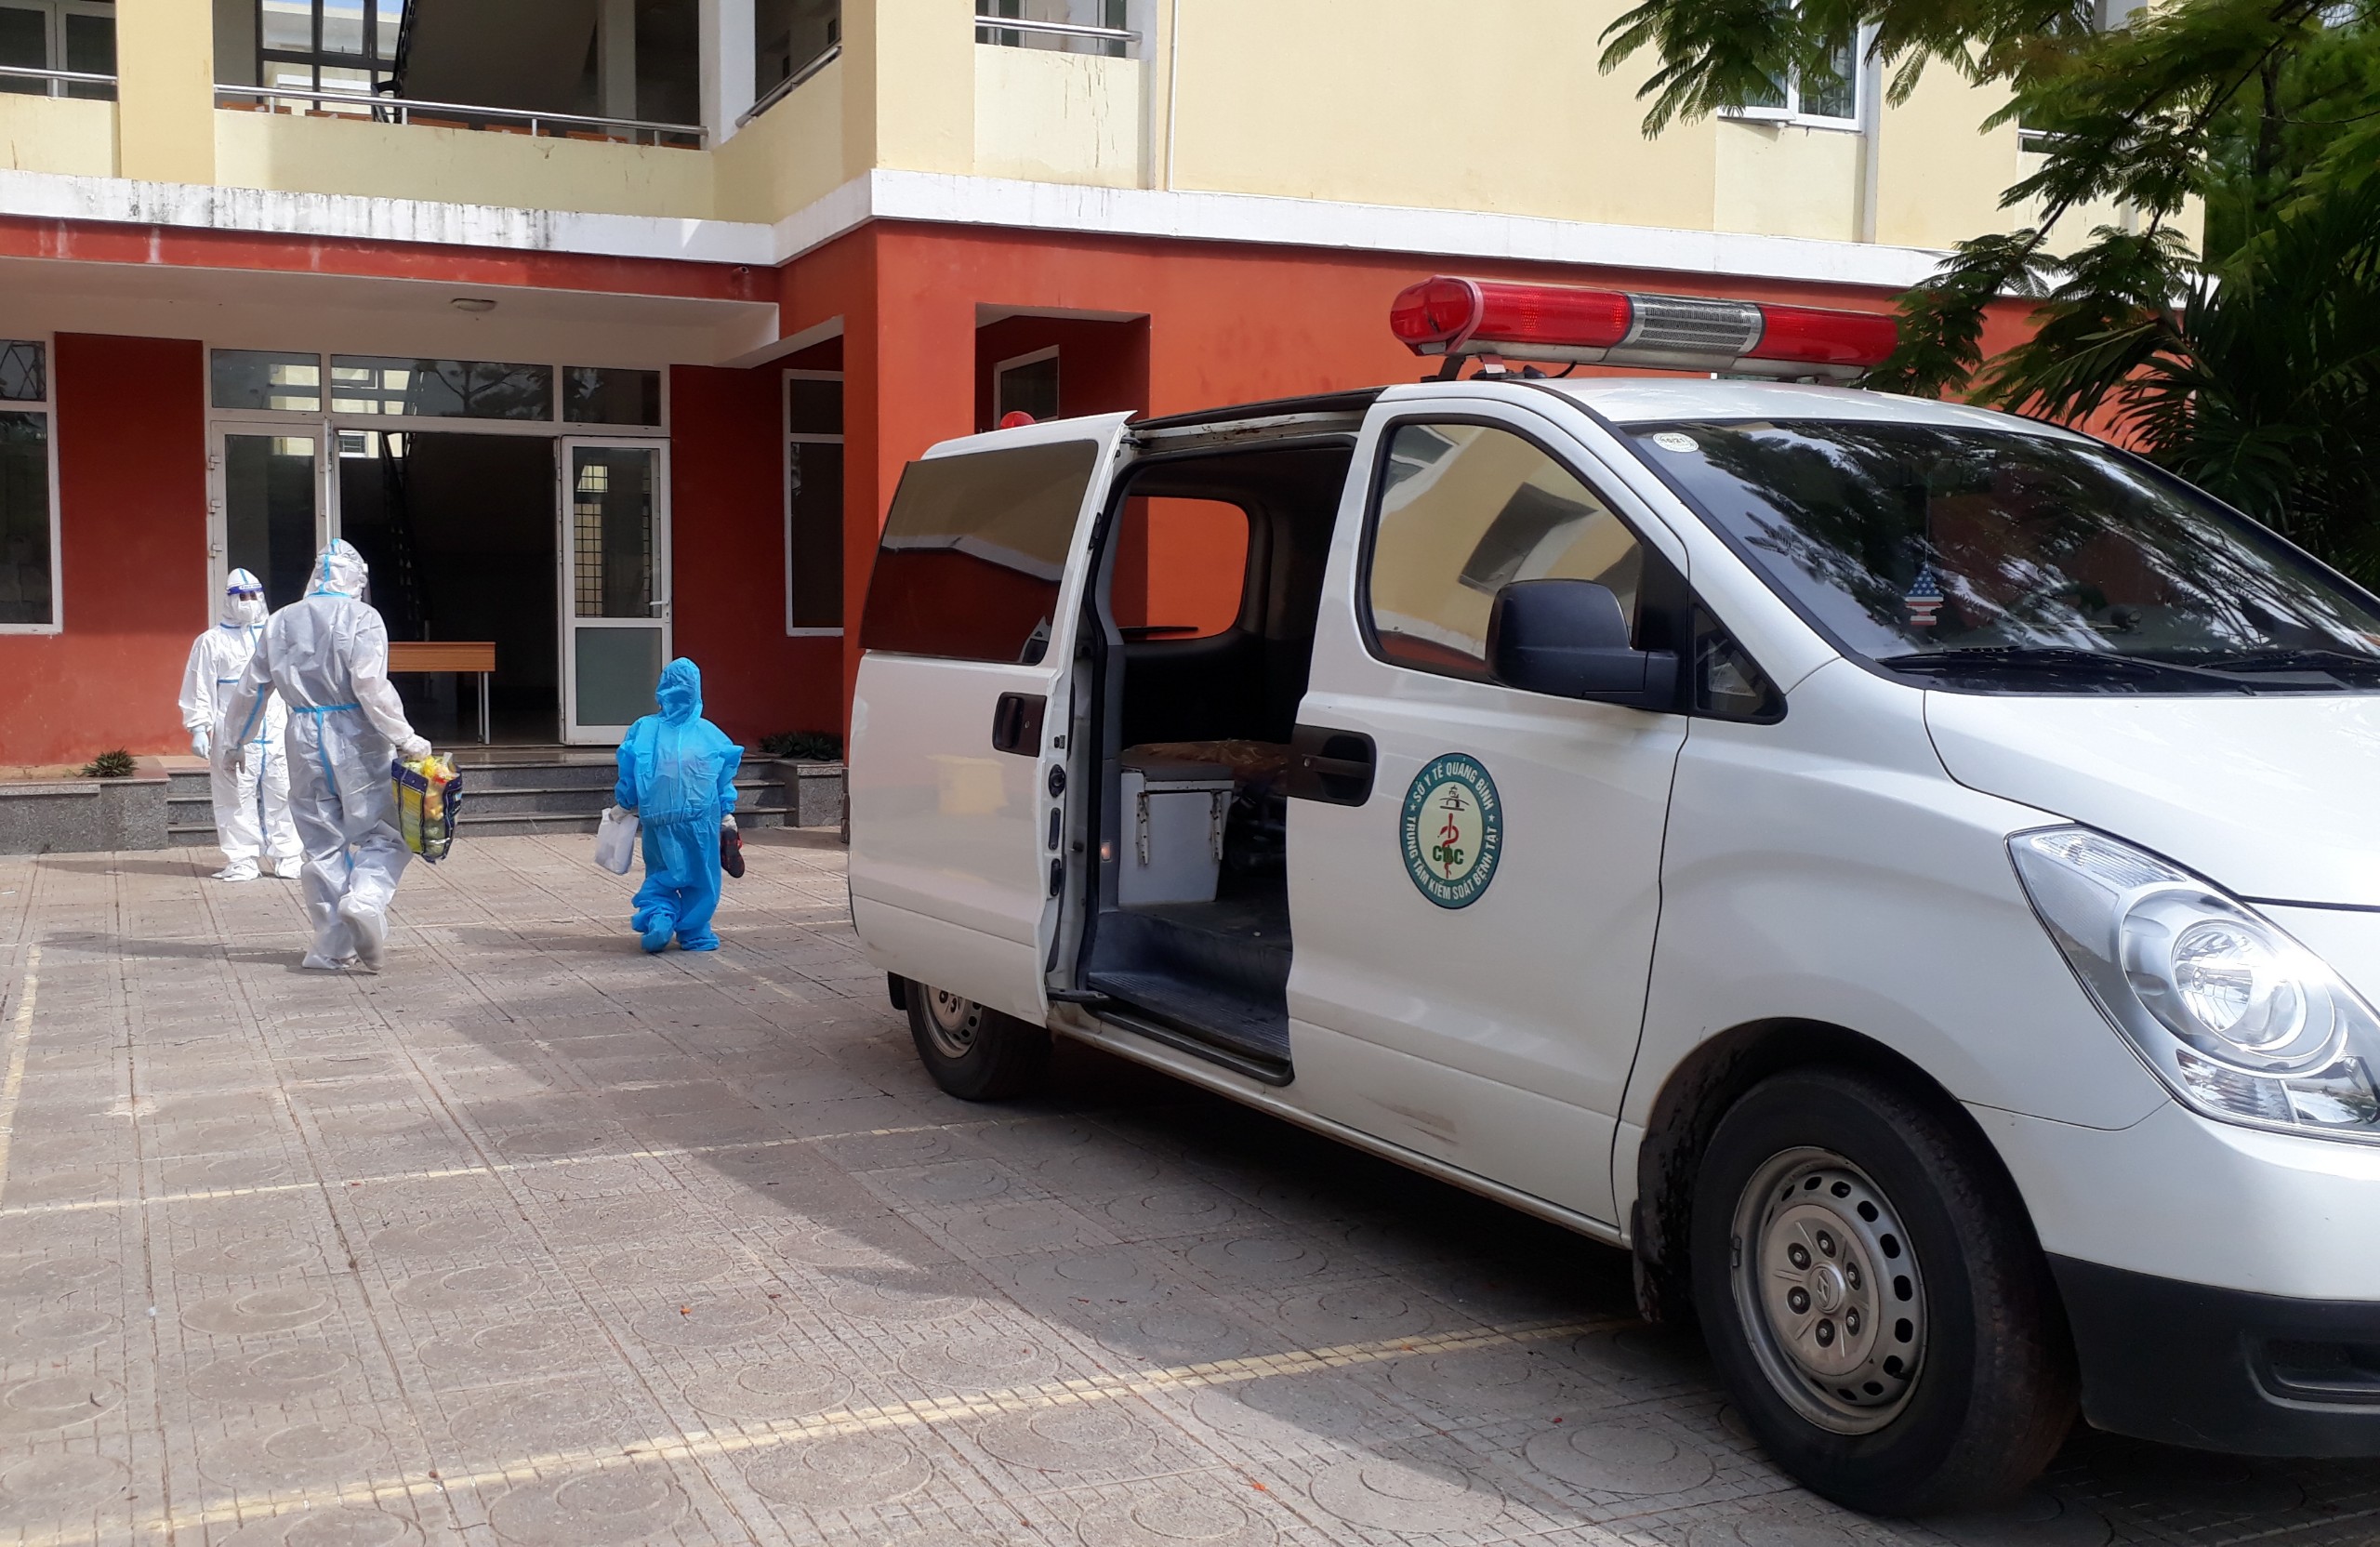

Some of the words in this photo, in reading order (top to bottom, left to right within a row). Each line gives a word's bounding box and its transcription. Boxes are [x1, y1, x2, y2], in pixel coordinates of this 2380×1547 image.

[1413, 781, 1425, 802] SỞ
[1424, 774, 1432, 787] Y
[1432, 760, 1444, 780] TẾ
[1446, 758, 1477, 784] QUẢNG
[1475, 778, 1494, 810] BÌNH
[1407, 816, 1418, 859] TRUNG
[1413, 858, 1430, 885] TÂM
[1428, 879, 1451, 900] KIỂM
[1452, 879, 1474, 900] SOÁT
[1473, 852, 1493, 886] BỆNH
[1485, 826, 1499, 850] TẬT
[1433, 845, 1463, 866] CDC
